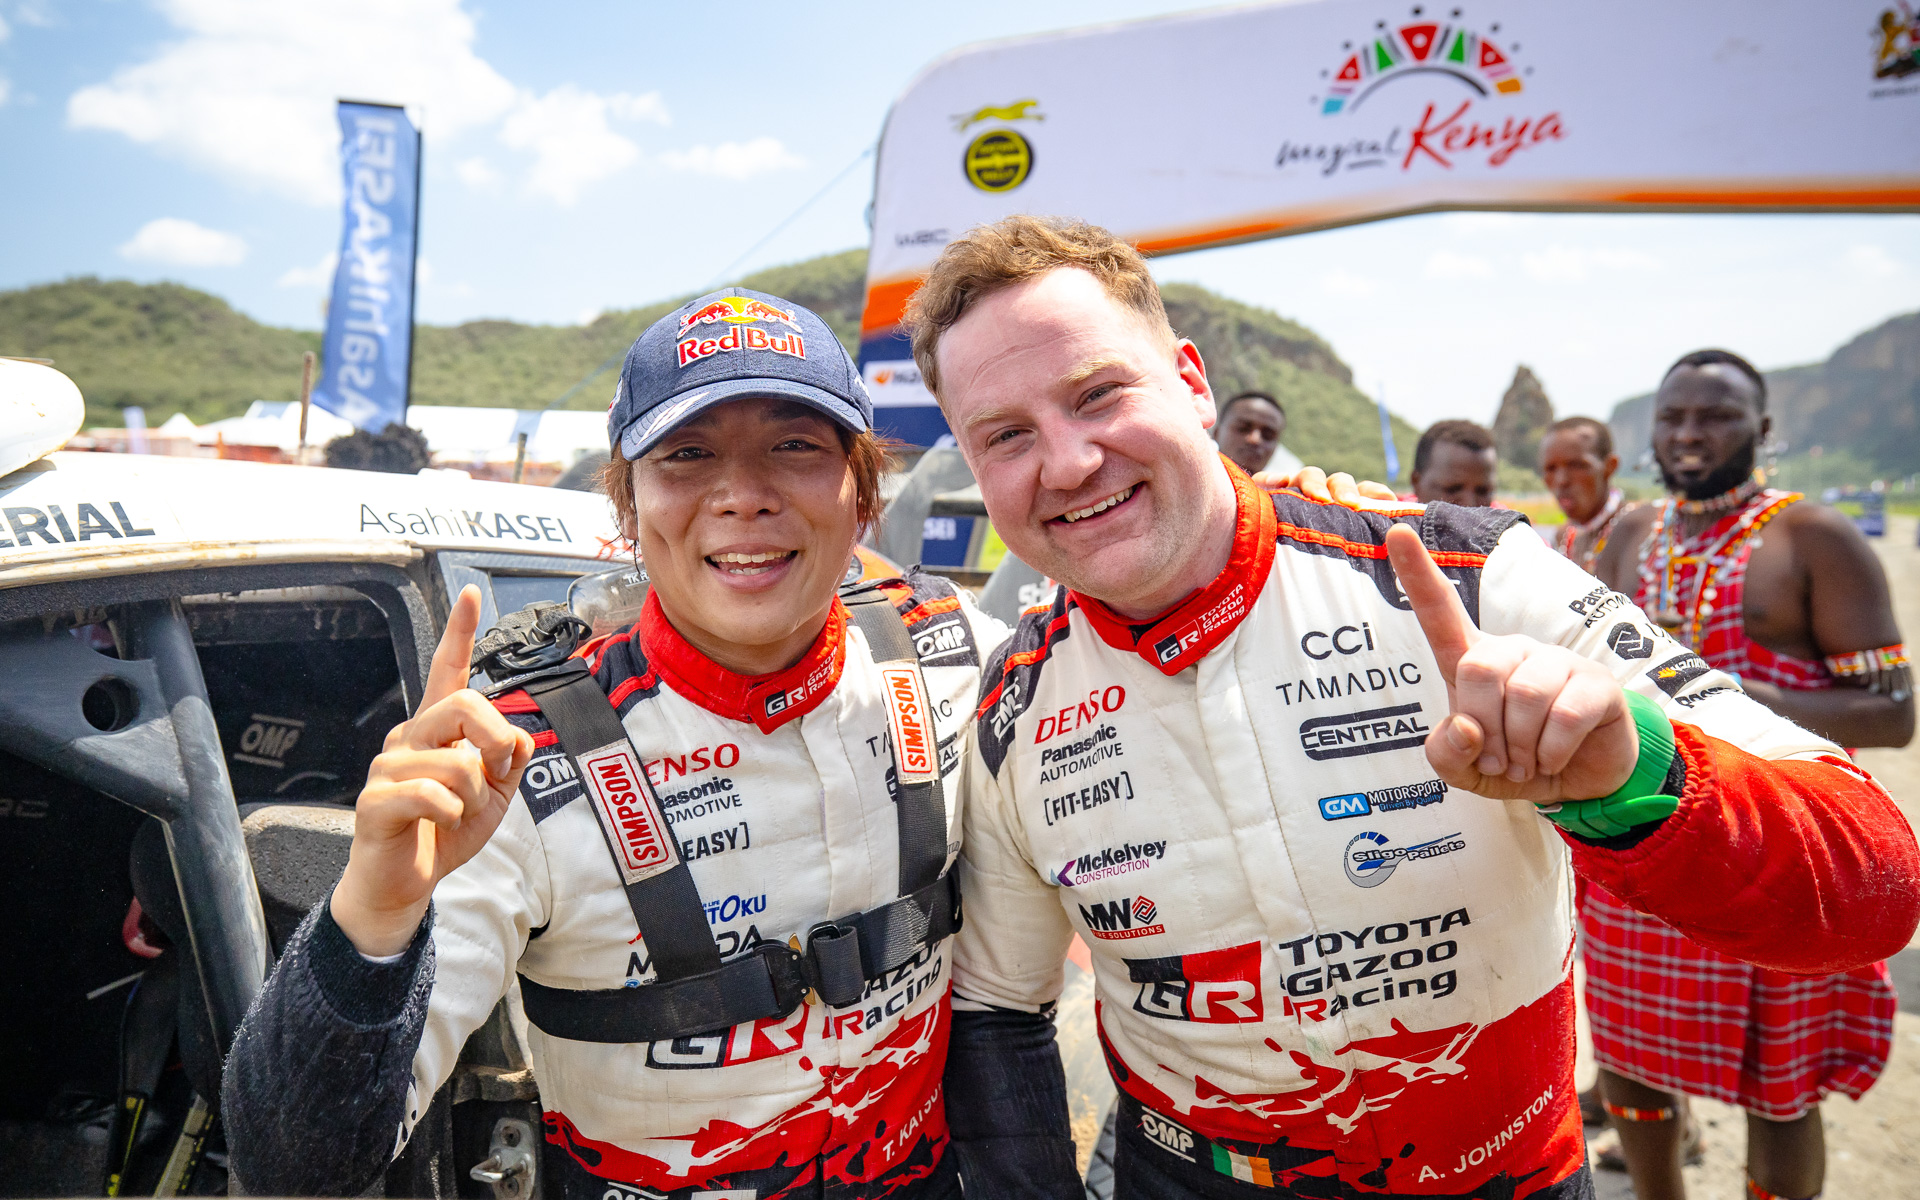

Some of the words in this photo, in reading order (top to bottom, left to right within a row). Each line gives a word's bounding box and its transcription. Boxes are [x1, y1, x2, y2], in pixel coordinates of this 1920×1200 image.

[1402, 99, 1561, 170] Kenya
[677, 325, 743, 368] Red
[744, 326, 806, 360] Bull
[360, 503, 573, 543] AsahiKASEI
[924, 517, 956, 541] SEI
[1198, 583, 1244, 620] TOYOTA
[1202, 595, 1244, 630] GAZOO
[1204, 605, 1245, 635] Racing
[917, 626, 966, 656] OMP
[1159, 629, 1200, 663] GR
[767, 686, 805, 715] GR
[1276, 662, 1422, 705] TAMADIC
[890, 676, 927, 768] SIMPSON
[1034, 685, 1126, 744] DENSO
[240, 722, 299, 758] OMP
[1300, 717, 1429, 749] CENTRAL
[527, 757, 577, 790] OM
[644, 743, 740, 787] ENSO
[664, 776, 733, 808] asonic
[665, 794, 742, 824] OMOTIVE
[1368, 779, 1447, 805] MOTORSPORT
[598, 761, 660, 861] SIMPSON
[682, 821, 750, 861] EASY]
[1076, 840, 1167, 875] McKelvey
[1353, 848, 1407, 862] Sligo
[1407, 840, 1465, 861] Pallets
[1075, 858, 1150, 885] CONSTRUCTION
[1108, 925, 1163, 940] SOLUTIONS
[1279, 907, 1471, 967] TOYOTA
[1280, 940, 1458, 998] GAZOO
[822, 955, 942, 1040] Racing
[1130, 975, 1262, 1022] GR
[1284, 969, 1458, 1024] Racing
[882, 1140, 896, 1162] T.
[1141, 1114, 1194, 1153] OMP
[1418, 1165, 1446, 1184] A.
[1454, 1085, 1553, 1174] JOHNSTON
